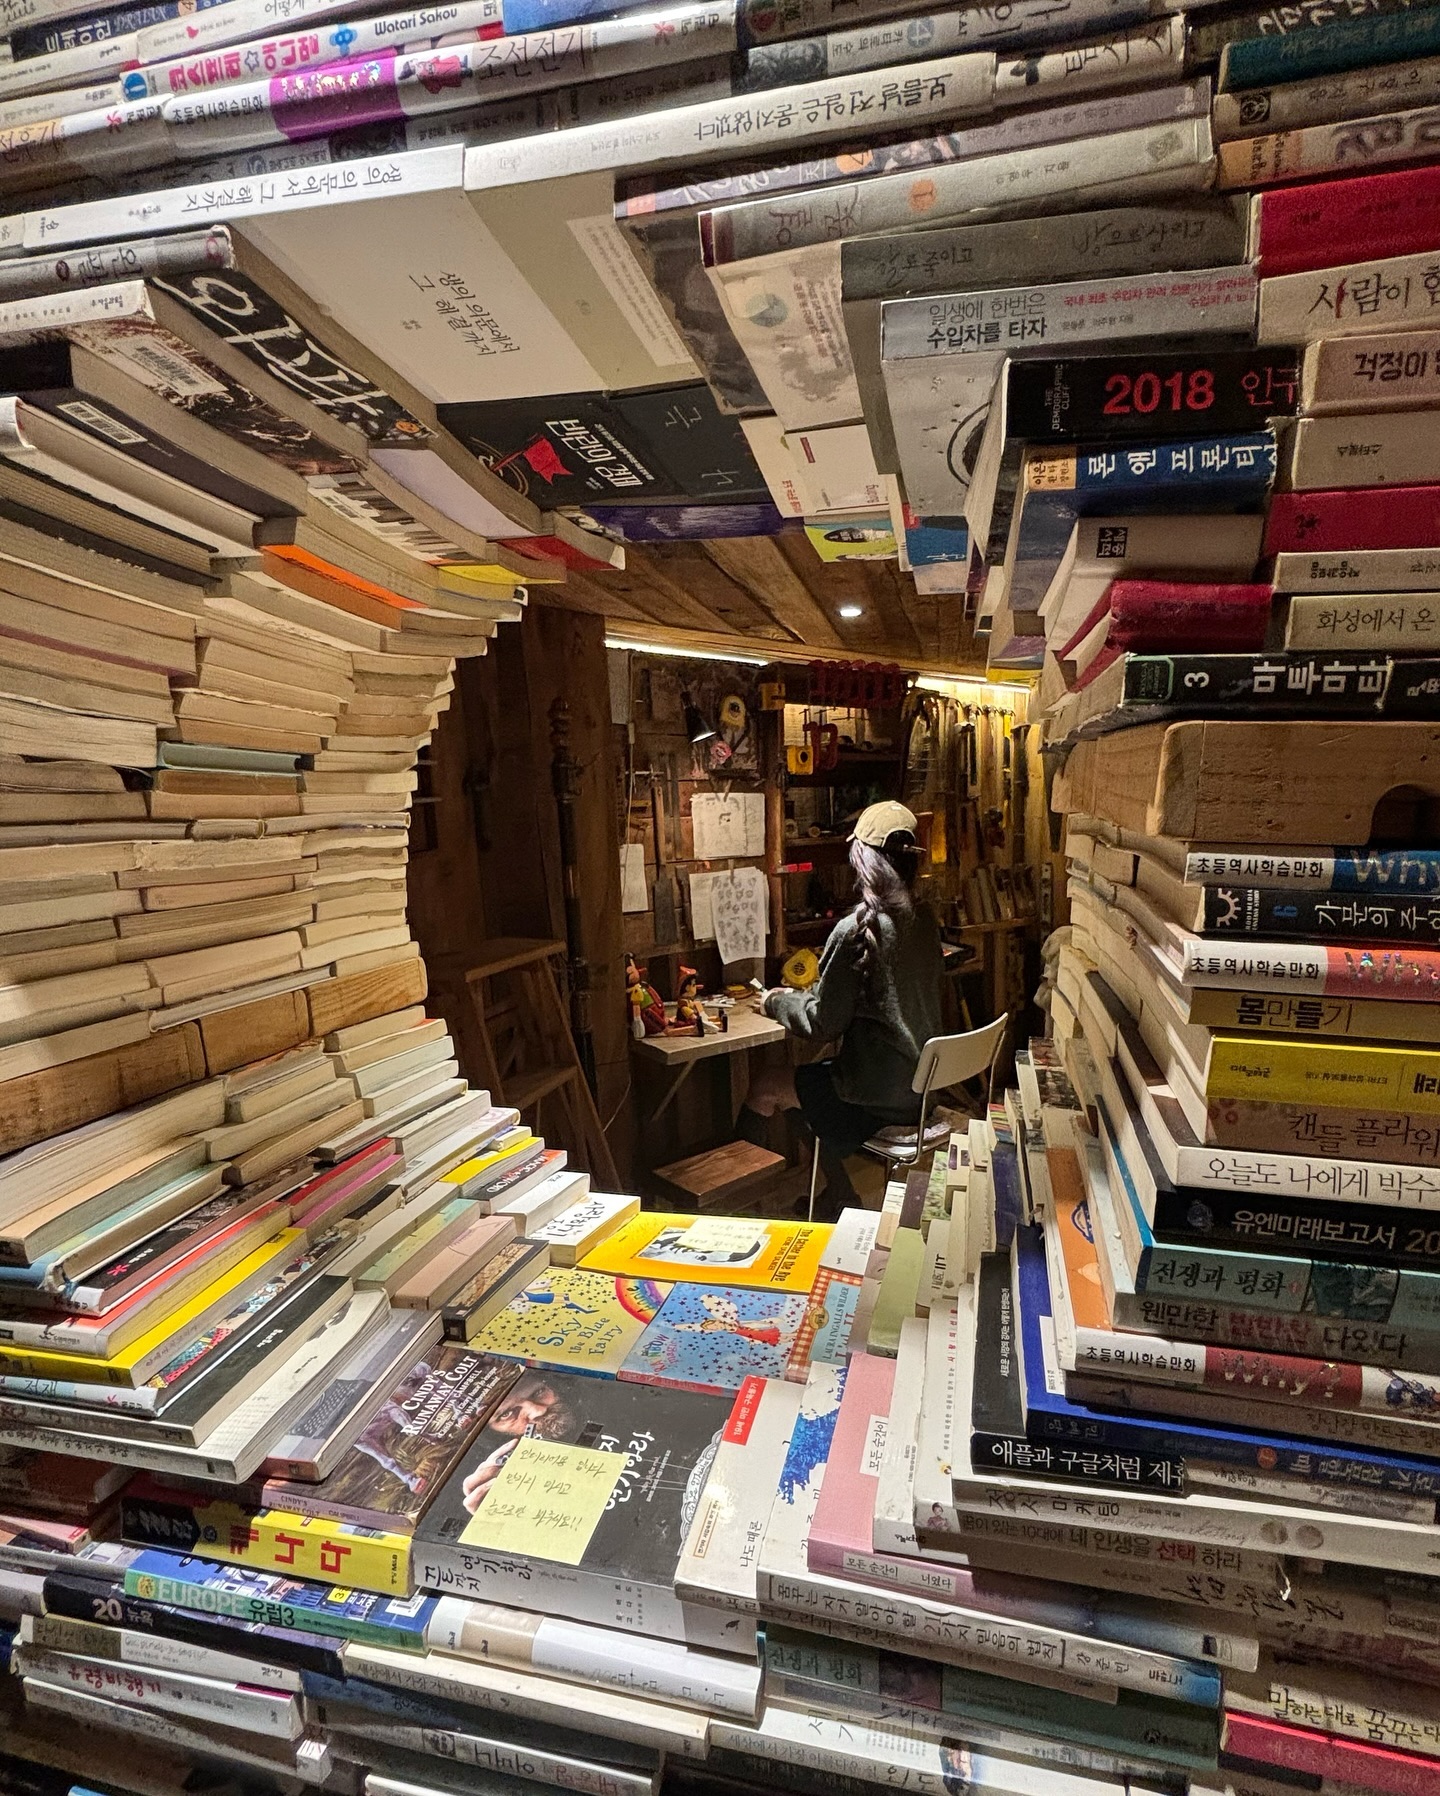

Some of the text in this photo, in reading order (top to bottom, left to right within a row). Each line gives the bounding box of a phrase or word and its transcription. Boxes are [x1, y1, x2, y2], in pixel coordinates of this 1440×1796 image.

[374, 7, 458, 36] Watari Sakou
[479, 27, 586, 78] 조선전기
[173, 96, 264, 125] 초등역사학습만화
[693, 73, 953, 140] 보름날 전 일은 묻지 않겠다
[260, 183, 275, 200] 그
[283, 170, 357, 197] 의문에서
[438, 271, 520, 354] 생의 의문에서
[929, 292, 1047, 326] 일생에 한번은
[1308, 274, 1409, 317] 사람이
[408, 275, 497, 355] 그 해결까지
[927, 323, 1002, 349] 수입차를
[1008, 317, 1048, 340] 타자
[1354, 352, 1428, 381] 걱정이
[1052, 363, 1061, 430] DEMOGRAPHIC
[1103, 369, 1215, 415] 2018
[1088, 453, 1116, 479] 론
[1128, 448, 1157, 475] 앤
[1317, 608, 1436, 632] 화성에서 온
[1184, 660, 1388, 695] 3 마투마타
[1196, 857, 1324, 879] 초등역사학습만화
[1314, 900, 1395, 928] 가문의
[1191, 957, 1320, 980] 초등역사학습만화
[1236, 997, 1353, 1033] 몸만들기
[1288, 1112, 1346, 1153] 캔들
[1202, 1157, 1281, 1187] 오늘도
[1289, 1163, 1369, 1197] 나에게
[1231, 1210, 1396, 1250] 유엔미래보고서
[1153, 1258, 1289, 1299] 전쟁과 평화
[537, 1317, 581, 1348] Sky
[568, 1315, 612, 1355] the Blue
[588, 1323, 625, 1356] Fairy
[822, 1343, 835, 1360] LAURA
[831, 1311, 843, 1343] INGALLS
[840, 1287, 849, 1312] WILDER
[1085, 1346, 1197, 1373] 초등역사학습만화
[400, 1355, 479, 1437] RUNAWAY COLT
[401, 1366, 449, 1412] CINDY'S
[453, 1369, 484, 1400] CAMPBELL
[733, 1418, 746, 1437] 19세
[868, 1420, 889, 1472] 모든 순간이
[992, 1440, 1052, 1471] 애플과
[1059, 1450, 1141, 1480] 구글처럼
[1051, 1495, 1120, 1517] 마케팅
[740, 1520, 763, 1567] 나도 때론
[991, 1518, 1017, 1538] 있는
[1022, 1522, 1063, 1544] 10대에
[1069, 1527, 1088, 1549] 네
[1093, 1530, 1151, 1557] 인생을
[1157, 1539, 1197, 1565] 선택
[1201, 1548, 1243, 1573] 하라
[425, 1566, 482, 1592] 끝까지
[463, 1553, 533, 1582] 연기하라
[846, 1556, 952, 1588] 모든 순간이 너였다
[93, 1599, 122, 1621] 20
[158, 1579, 296, 1626] EUROPE 유럽3
[823, 1594, 850, 1615] 자가
[855, 1601, 898, 1626] 알아야
[901, 1611, 917, 1628] 할
[976, 1628, 1022, 1654] 믿음의
[1268, 1687, 1359, 1728] 말하는대로
